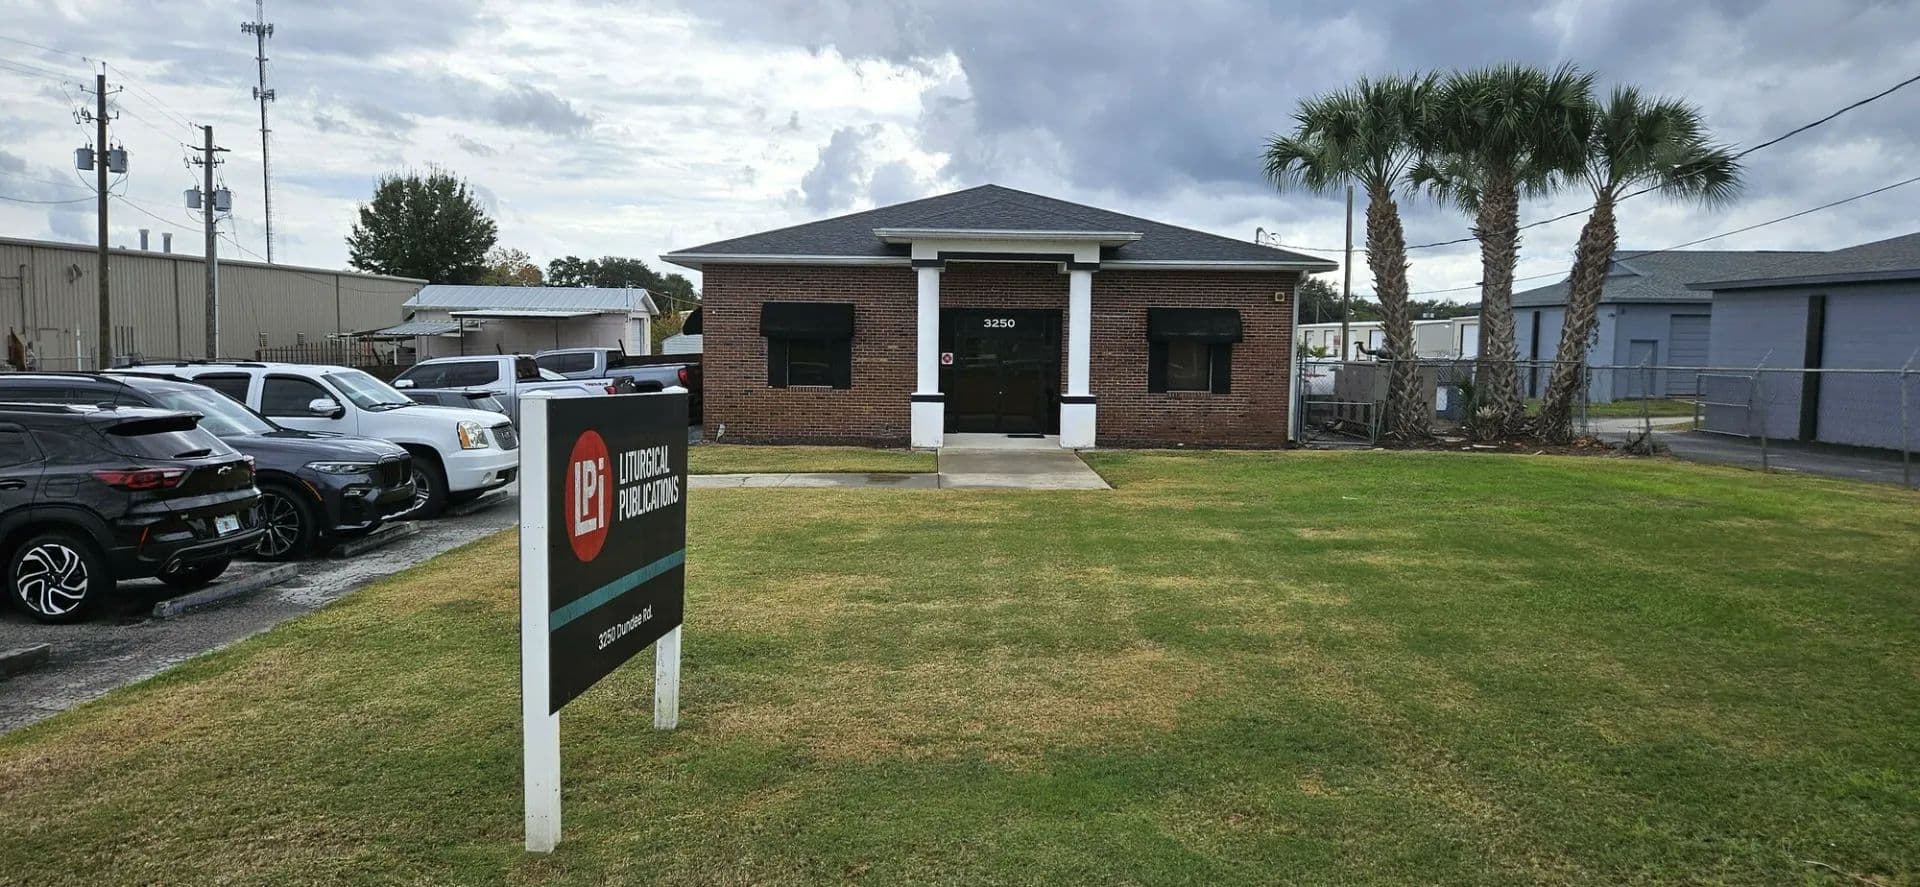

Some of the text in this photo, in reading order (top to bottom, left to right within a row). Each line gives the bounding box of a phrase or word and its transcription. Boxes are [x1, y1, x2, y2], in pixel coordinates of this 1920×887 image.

[984, 319, 1016, 328] 3250
[620, 445, 670, 485] LITURGICAL
[575, 458, 604, 536] LPi
[620, 475, 679, 521] PUBLICATIONS
[598, 604, 653, 650] 3250 Dundee Rd.
